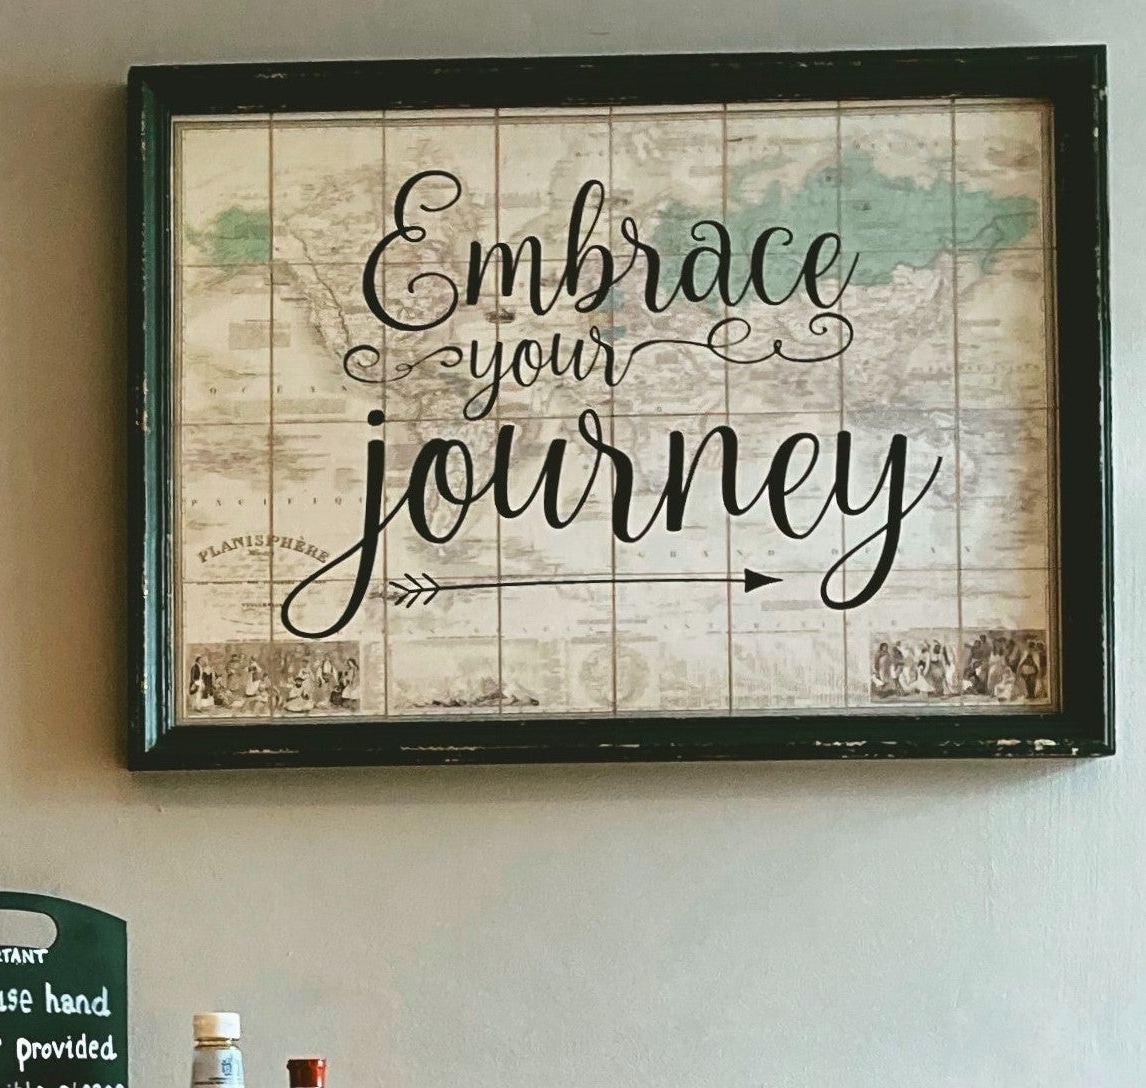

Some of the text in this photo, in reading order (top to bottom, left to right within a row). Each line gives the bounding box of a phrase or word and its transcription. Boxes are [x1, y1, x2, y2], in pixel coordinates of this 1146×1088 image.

[362, 170, 860, 332] Embrace
[463, 325, 633, 421] your
[198, 534, 330, 565] PLANISPHÈRE
[280, 409, 943, 639] journey
[45, 982, 111, 1018] hand
[16, 1033, 117, 1072] provided
